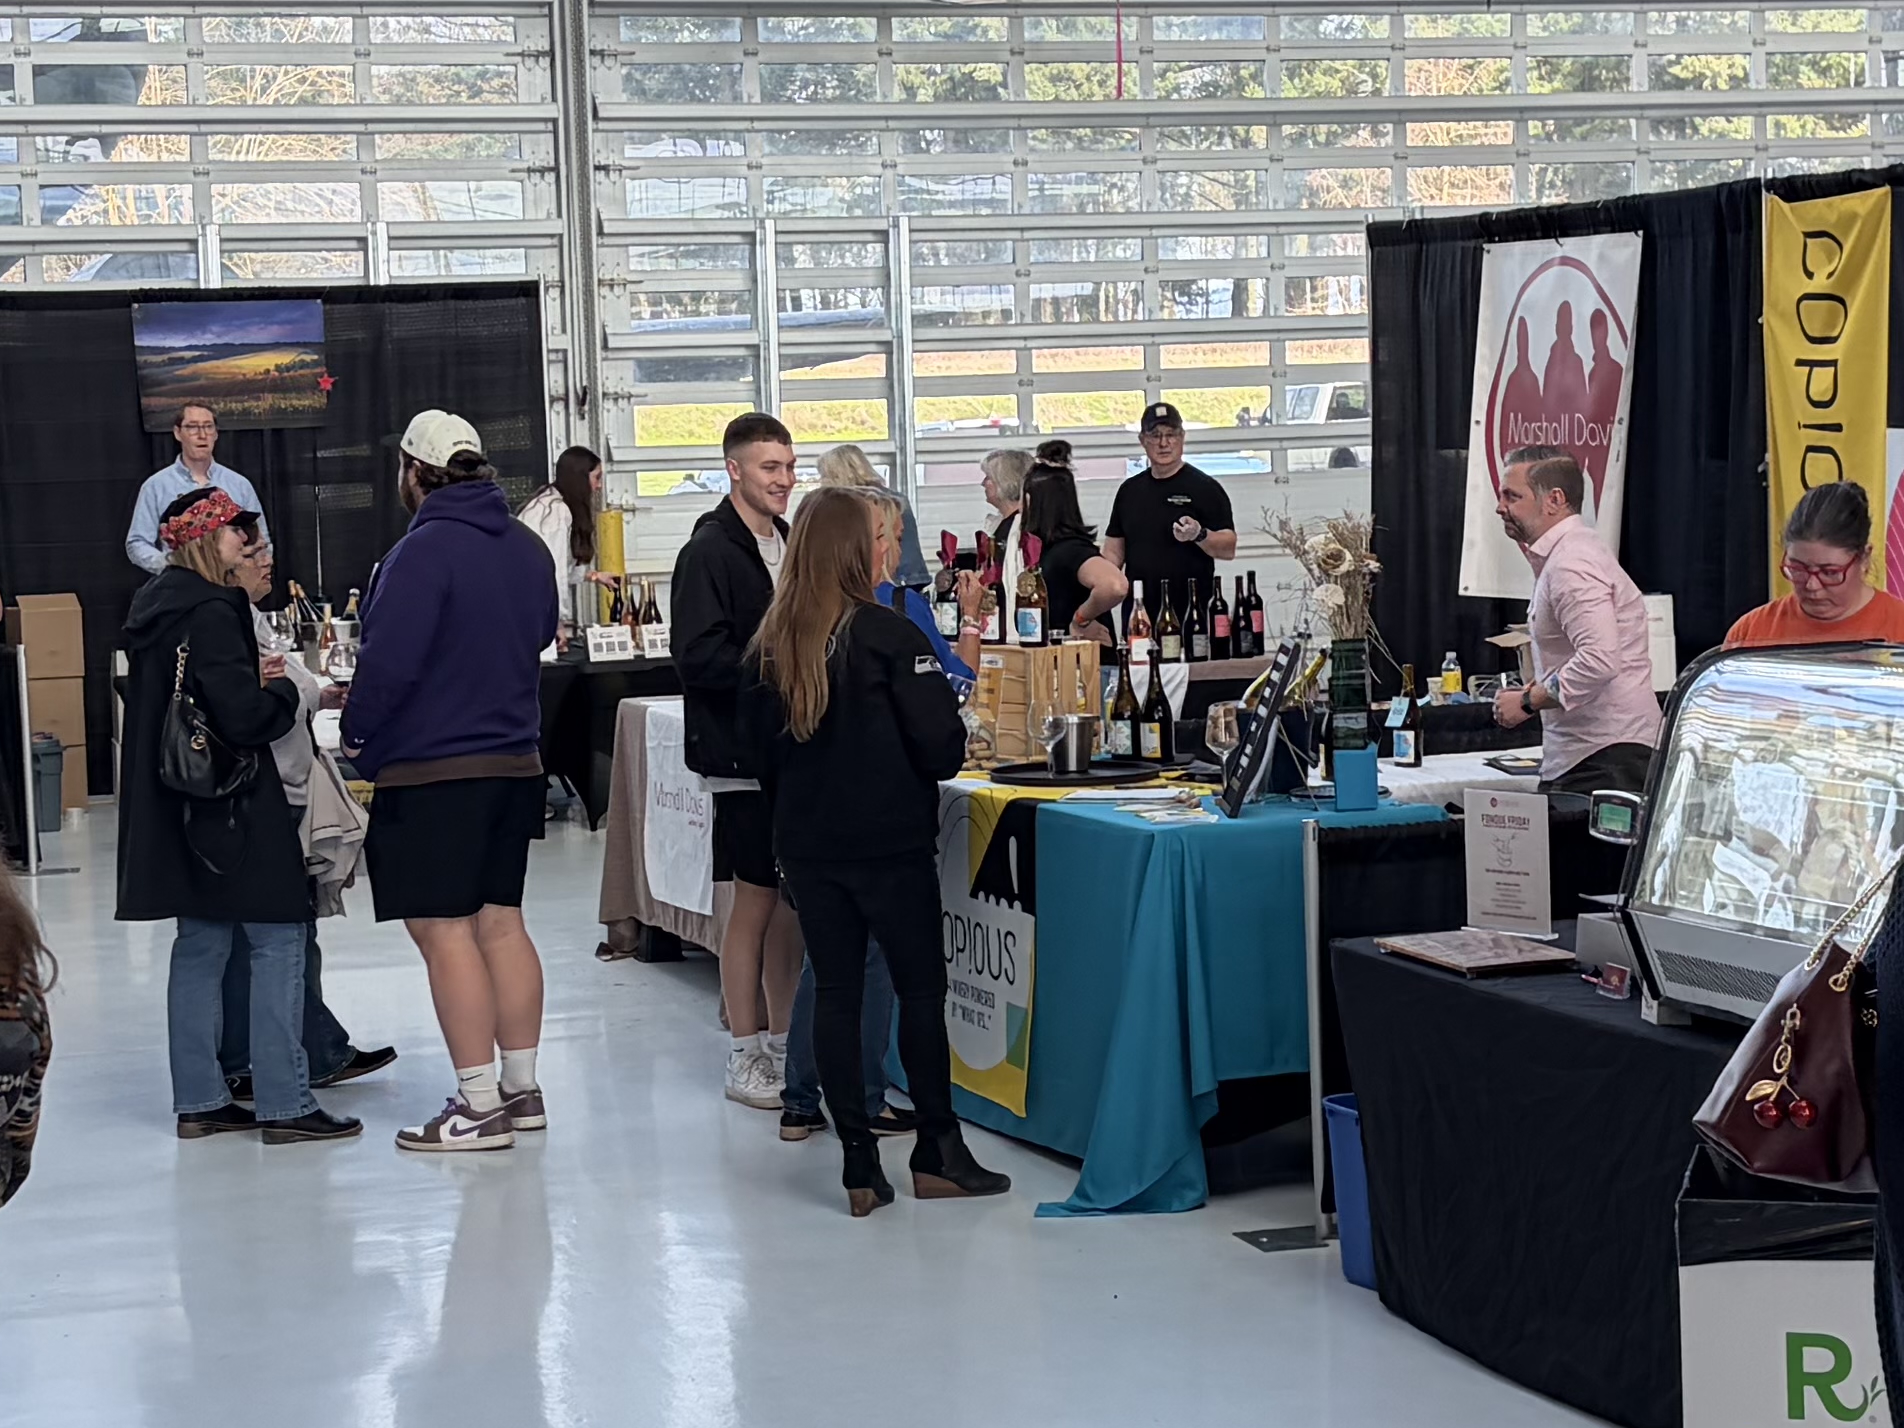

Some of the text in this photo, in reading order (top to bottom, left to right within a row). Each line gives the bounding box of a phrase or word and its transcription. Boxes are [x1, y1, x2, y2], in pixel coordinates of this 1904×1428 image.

[1794, 229, 1848, 492] COP!O
[1507, 412, 1615, 447] Marshall Davi
[942, 910, 1017, 986] OP!OUS
[1785, 1332, 1869, 1422] R
